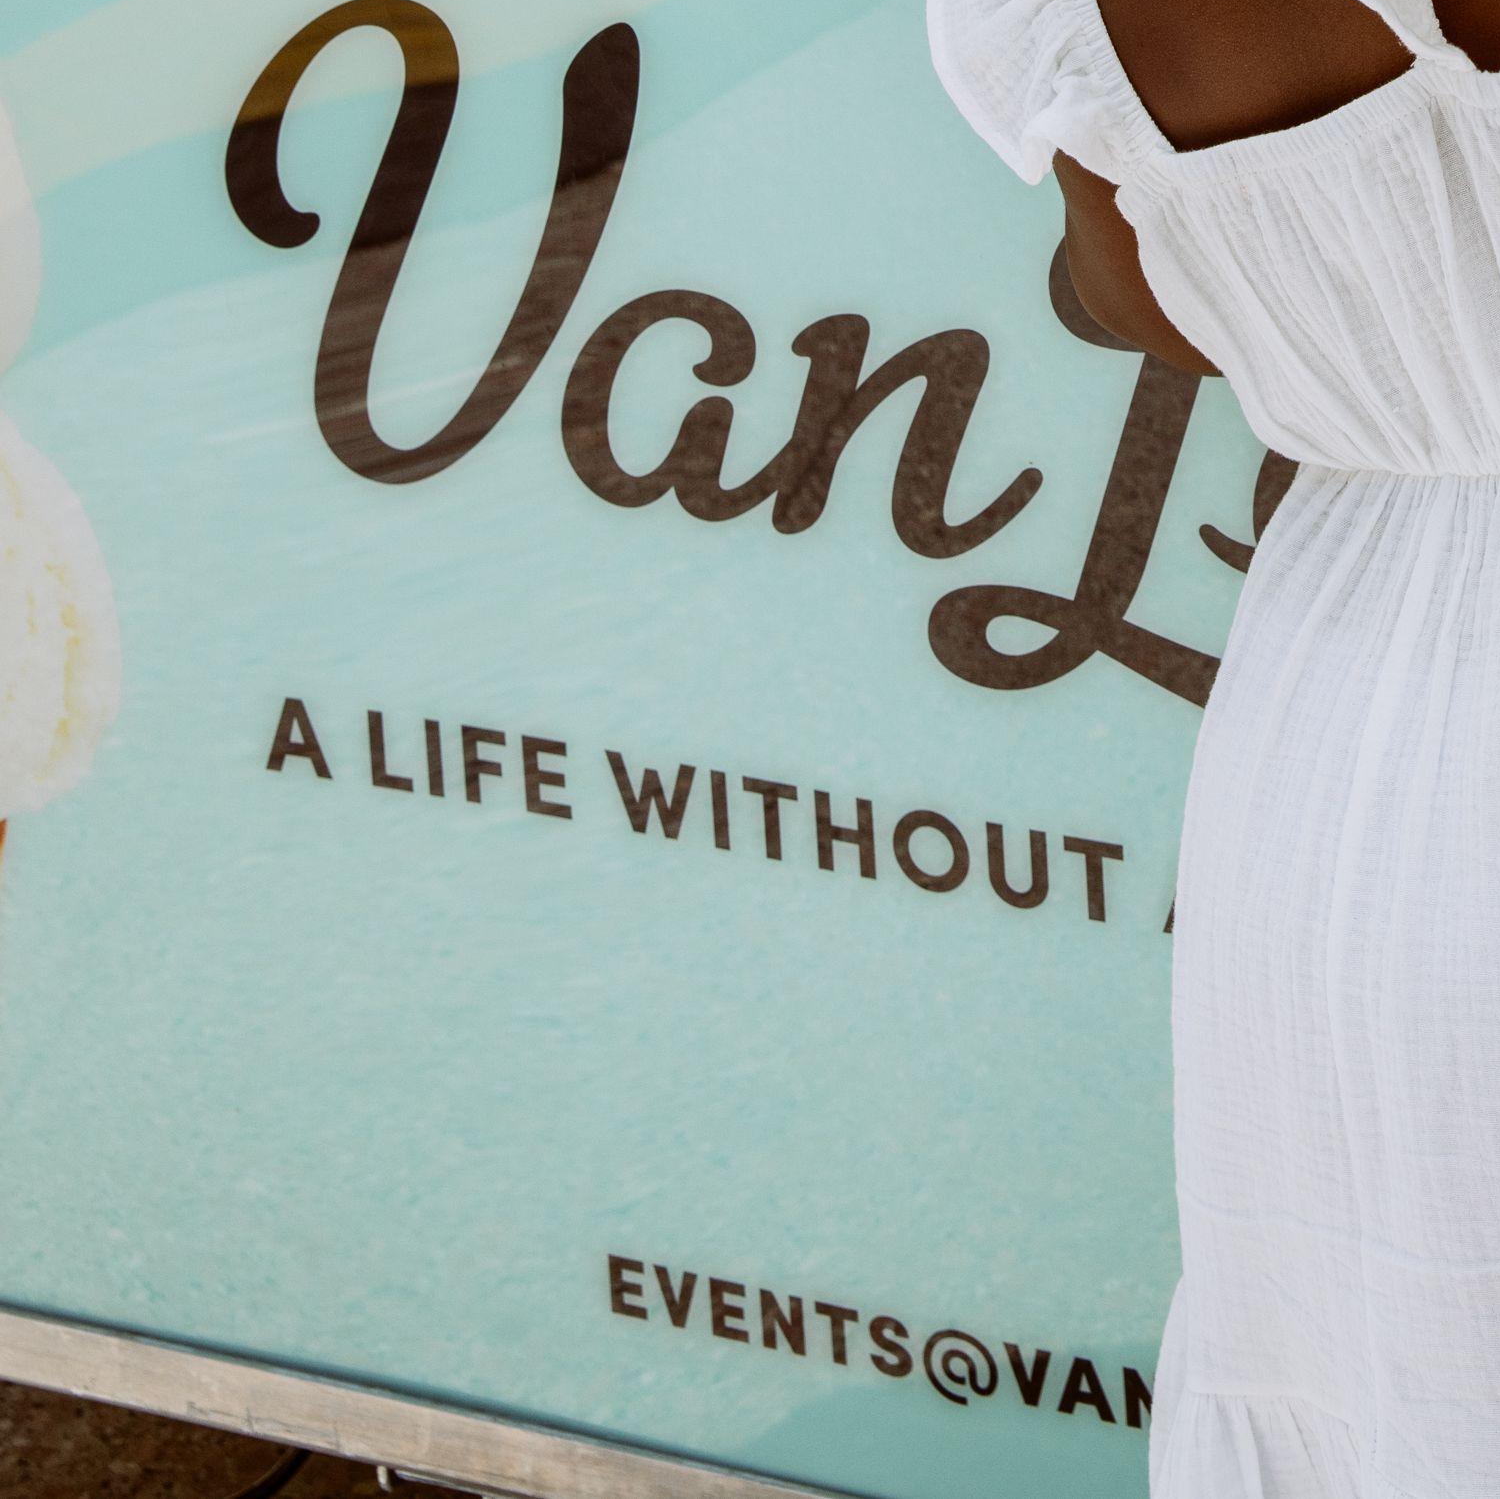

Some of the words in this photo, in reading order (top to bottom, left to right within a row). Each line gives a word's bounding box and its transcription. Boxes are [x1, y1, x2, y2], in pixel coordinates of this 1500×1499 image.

[265, 697, 333, 781] A
[366, 707, 574, 821] LIFE
[604, 748, 1126, 924] WITHOUT
